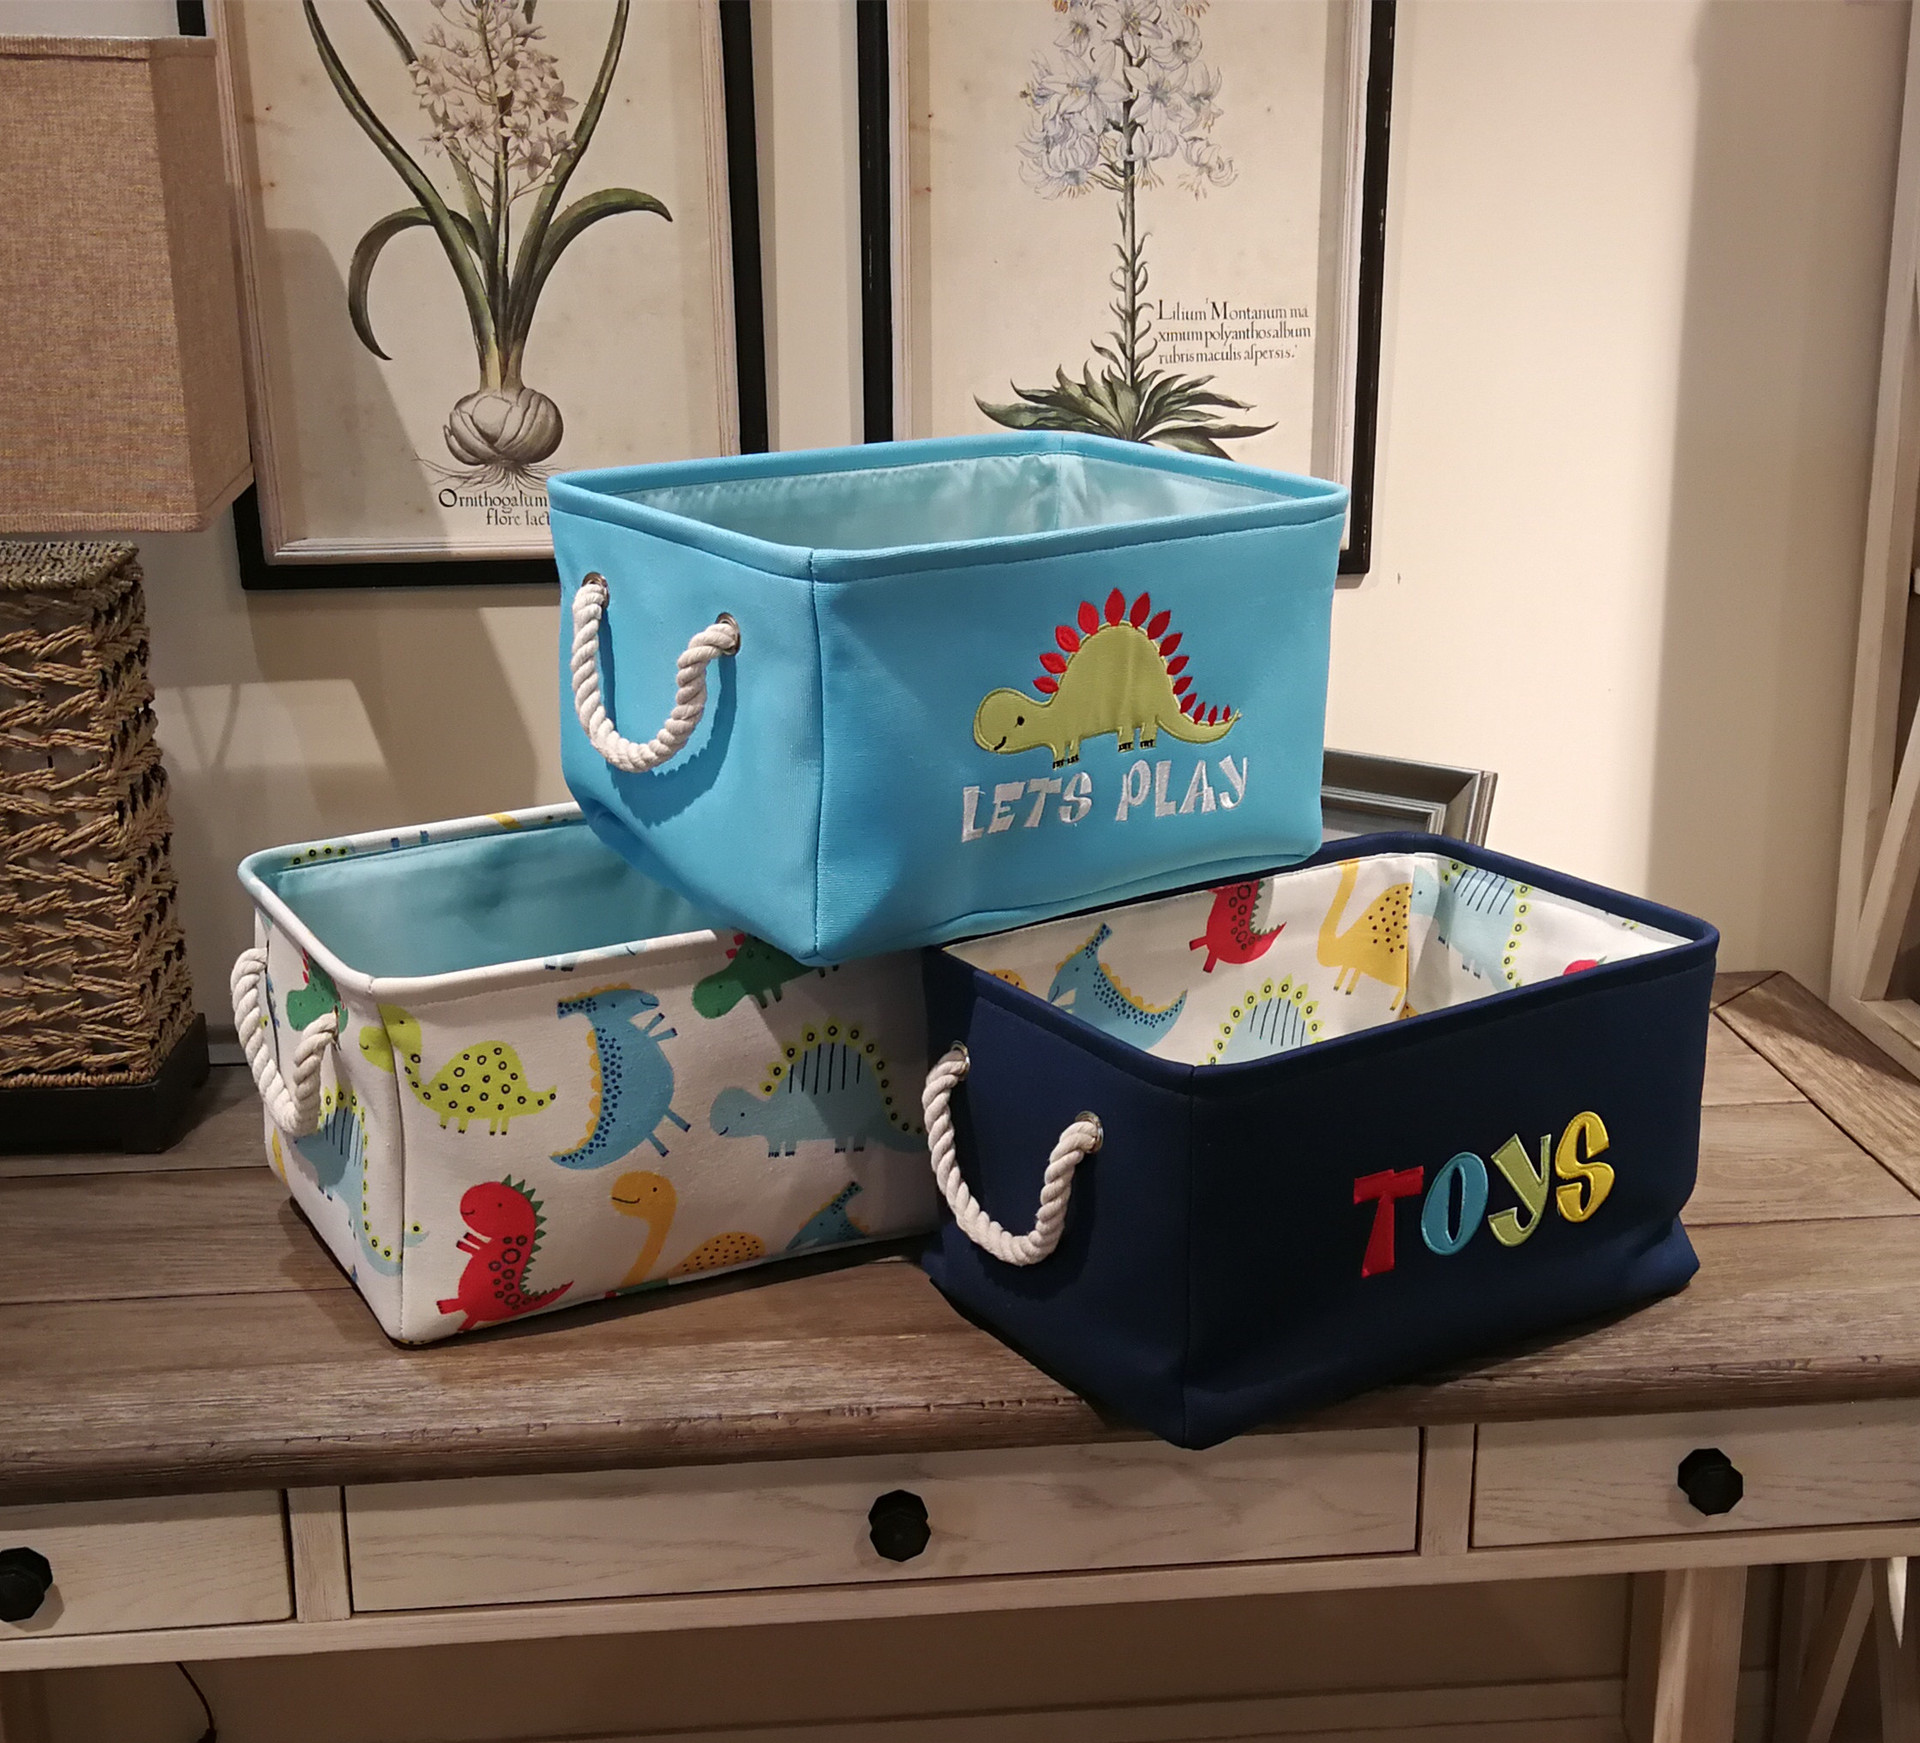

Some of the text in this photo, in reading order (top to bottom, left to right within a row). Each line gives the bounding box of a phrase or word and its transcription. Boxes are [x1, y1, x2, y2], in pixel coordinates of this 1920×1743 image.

[1156, 299, 1207, 321] Lilium
[1211, 301, 1287, 321] Montanum
[1272, 321, 1311, 339] album
[1158, 344, 1194, 365] rubris
[1196, 344, 1242, 363] maculis
[438, 488, 548, 514] Ornithogalum
[961, 754, 1248, 843] LETS PLAY
[1353, 1110, 1615, 1279] TOYS
